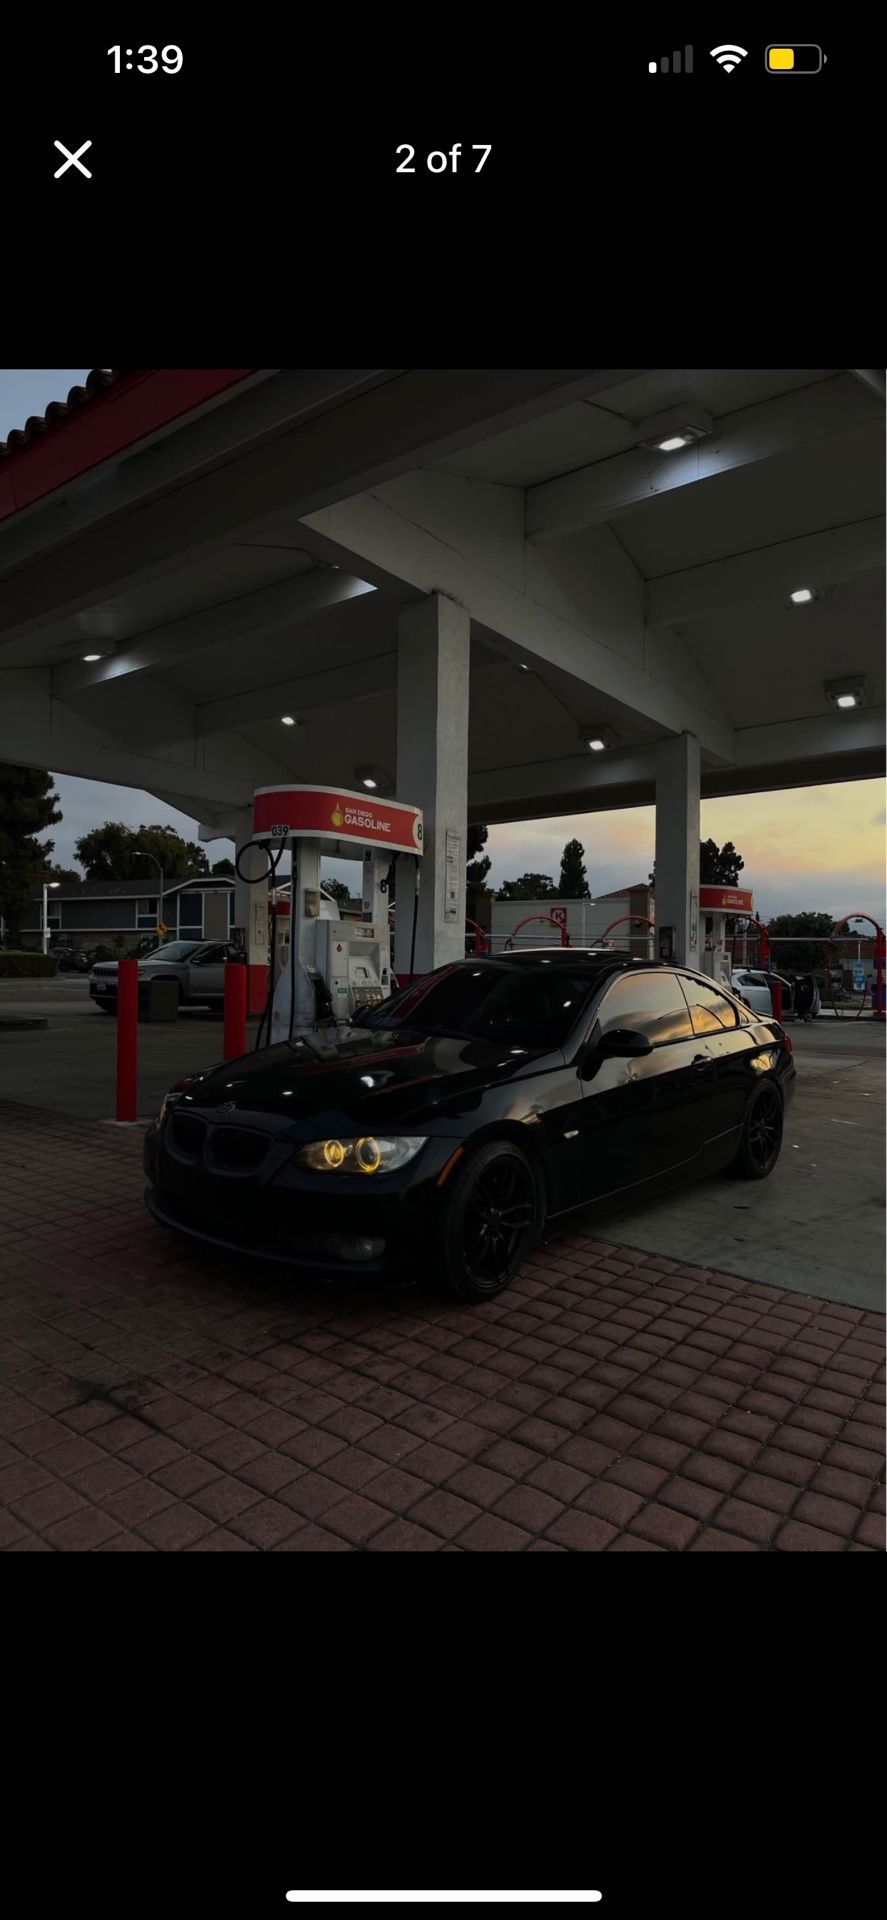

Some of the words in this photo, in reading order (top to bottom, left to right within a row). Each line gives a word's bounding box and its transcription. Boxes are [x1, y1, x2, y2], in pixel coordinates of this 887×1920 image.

[357, 810, 373, 818] DIEGO
[344, 814, 391, 832] GASOLINE
[271, 826, 289, 836] 039
[417, 824, 423, 839] 8
